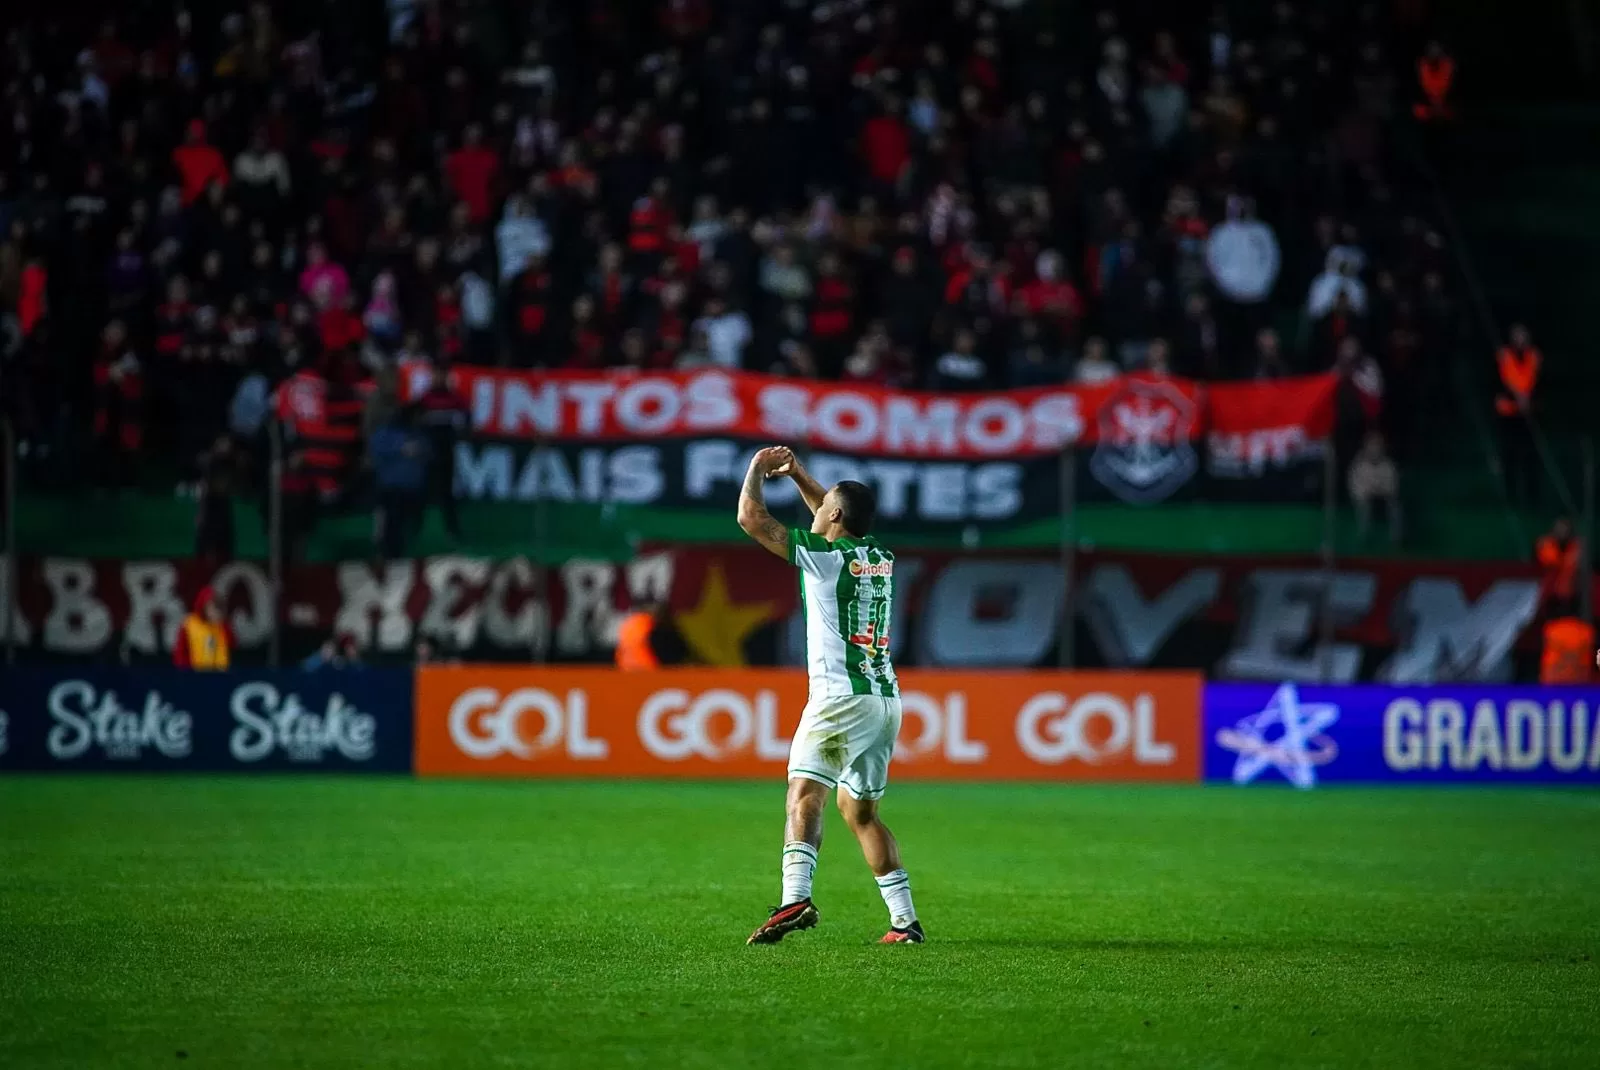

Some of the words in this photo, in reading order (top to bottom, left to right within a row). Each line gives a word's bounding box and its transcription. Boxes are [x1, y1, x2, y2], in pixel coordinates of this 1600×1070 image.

[758, 384, 1082, 457] SOMOS
[453, 440, 663, 503] MAIS
[48, 679, 193, 759] Stake
[229, 681, 376, 762] Stake
[449, 686, 609, 761] GOL
[637, 688, 792, 763] GOL
[892, 691, 988, 765] OL
[1015, 691, 1177, 766] GOL
